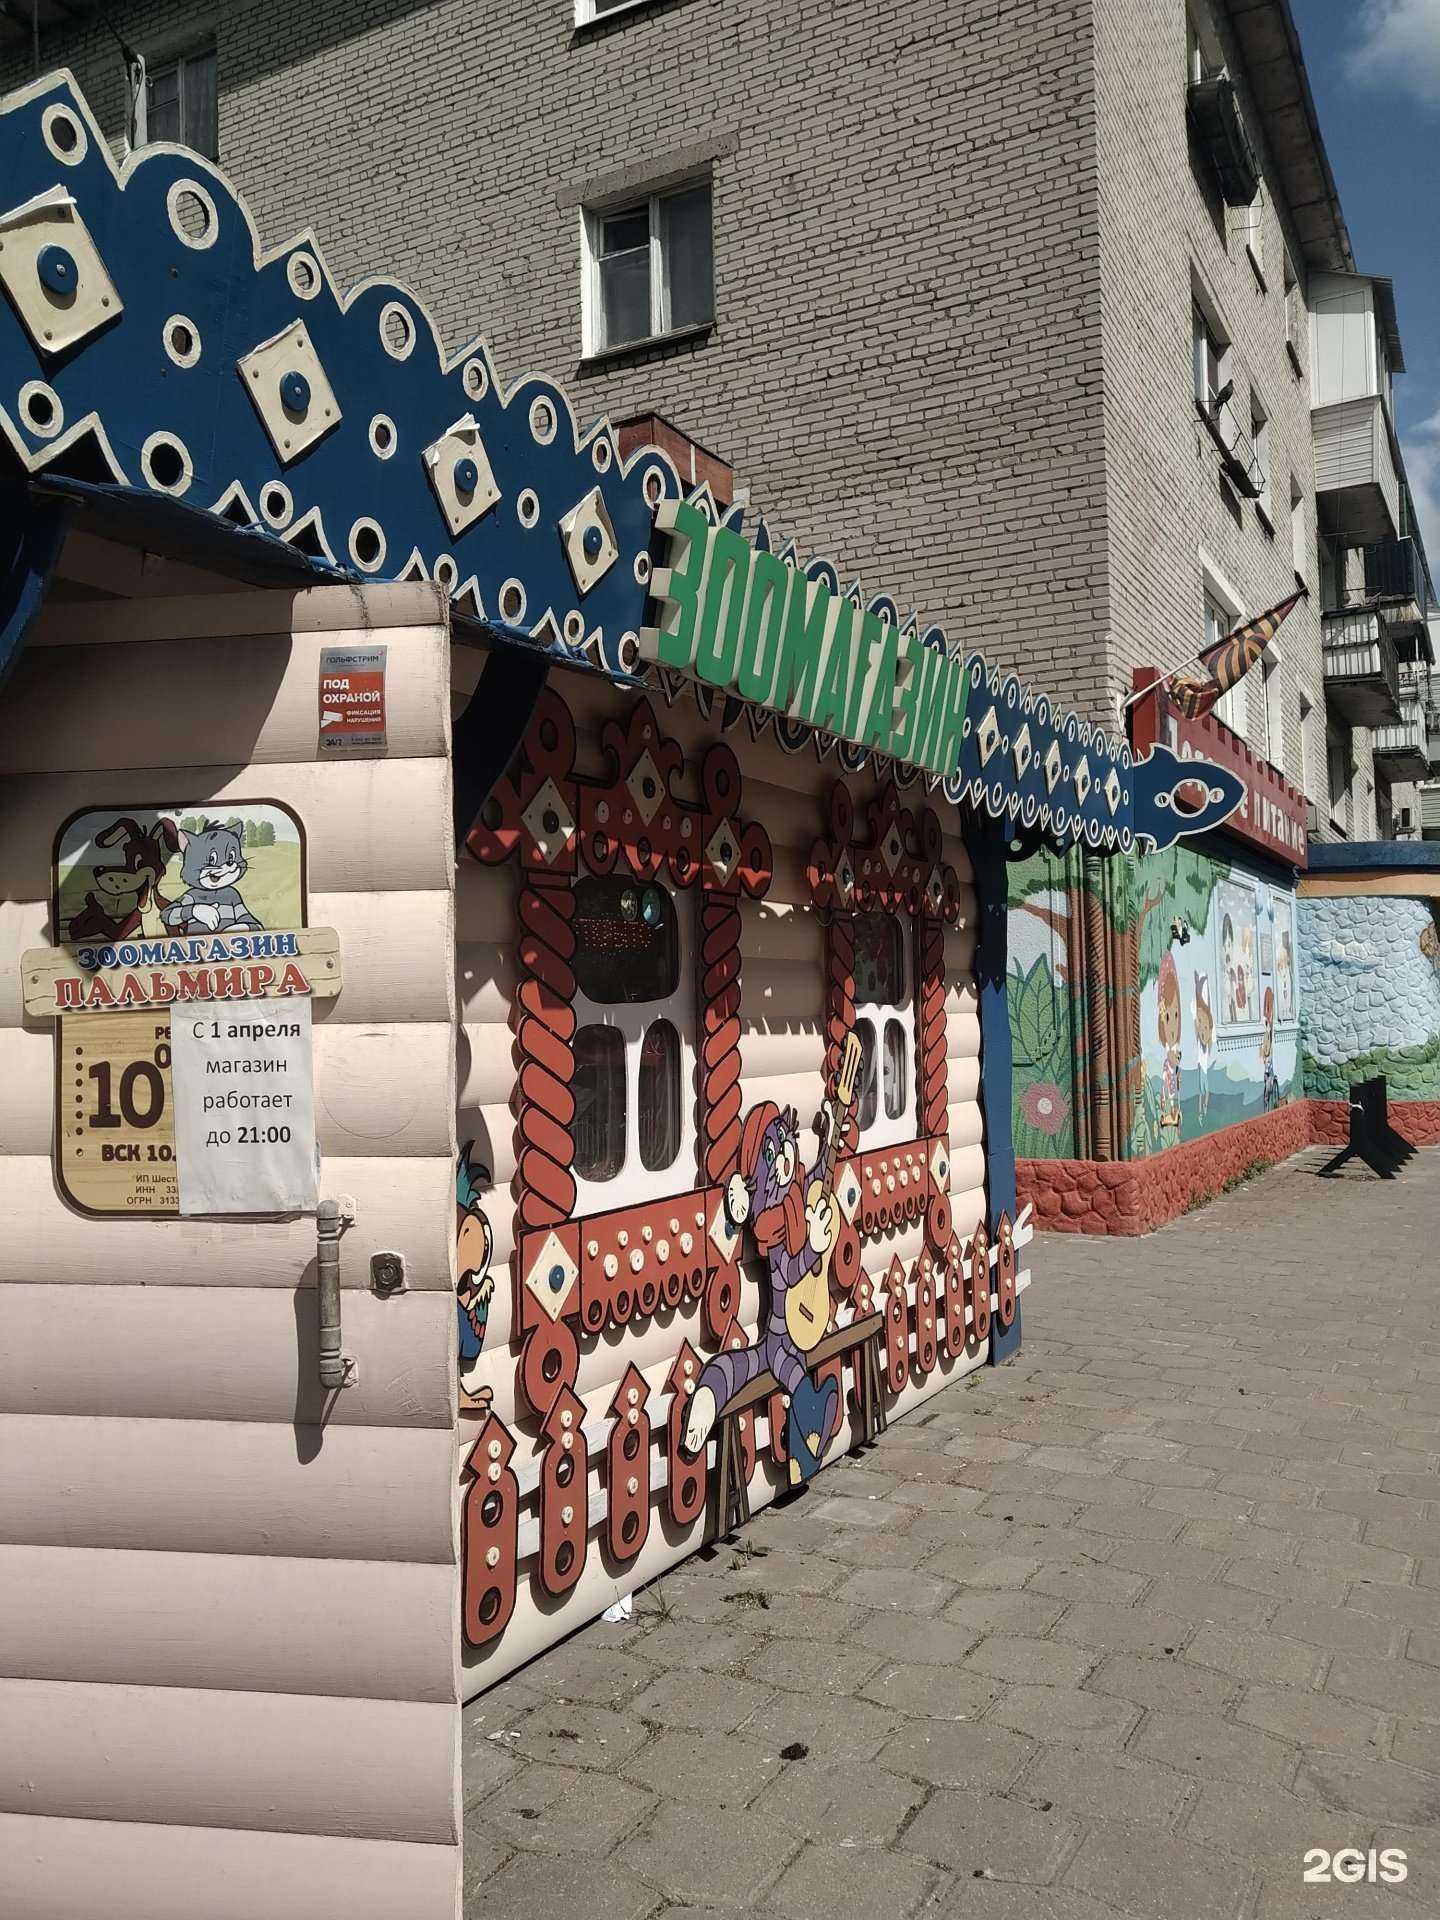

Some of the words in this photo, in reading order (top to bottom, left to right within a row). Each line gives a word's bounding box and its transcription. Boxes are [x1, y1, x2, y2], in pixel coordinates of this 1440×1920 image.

[643, 499, 971, 778] ЗООМАГАЗИН
[323, 679, 350, 690] ПОД
[323, 690, 381, 704] ОХРАНОЙ
[76, 933, 298, 969] ЗООМАГАЗИН
[54, 963, 311, 1009] ПАЛЬМИРА
[192, 1021, 204, 1039] С
[211, 1022, 221, 1038] 1
[227, 1022, 301, 1041] апреля
[206, 1058, 288, 1074] магазин
[203, 1090, 293, 1112] работает
[206, 1129, 231, 1147] до
[237, 1126, 291, 1144] 21:00
[101, 1144, 141, 1162] ВСК
[136, 1174, 149, 1183] ИП
[135, 1185, 155, 1194] ИНН
[166, 1185, 178, 1194] 33
[126, 1196, 152, 1205] ОГРН
